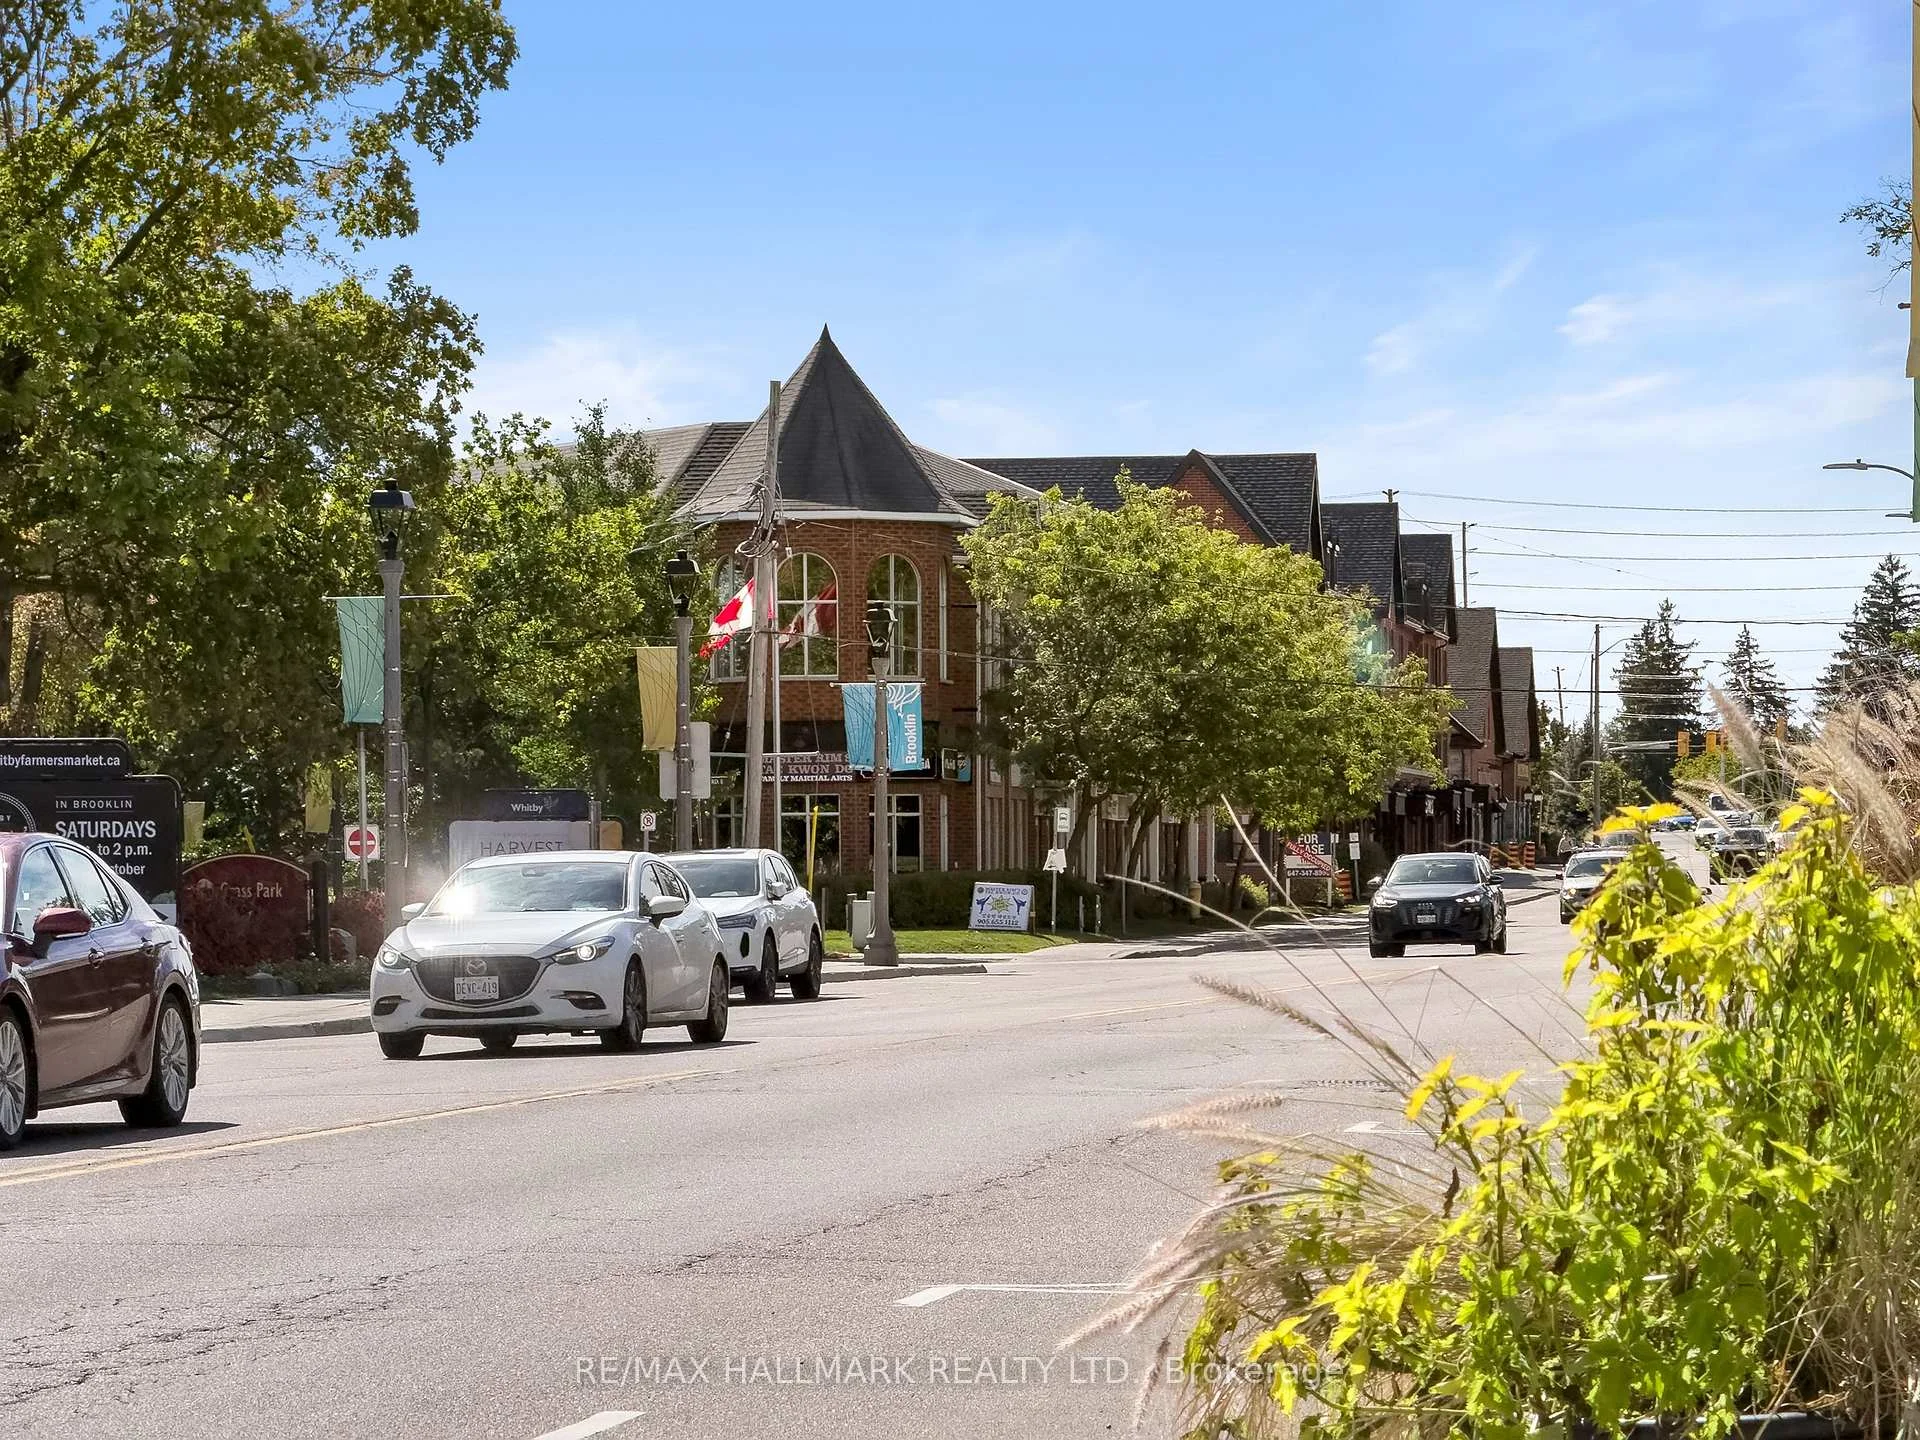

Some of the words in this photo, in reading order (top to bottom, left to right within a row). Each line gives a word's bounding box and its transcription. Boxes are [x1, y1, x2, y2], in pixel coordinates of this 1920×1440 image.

[904, 713, 917, 764] Brooklin
[788, 765, 830, 774] KWON
[55, 800, 67, 809] IN
[73, 800, 132, 809] BROOKLIN
[511, 803, 543, 814] Whitby
[55, 820, 156, 838] SATURDAYS
[1298, 833, 1319, 844] FOR
[97, 843, 110, 856] to
[112, 842, 122, 856] 2
[125, 845, 152, 858] p.m.
[480, 841, 565, 855] HARVEST
[110, 863, 145, 875] tober
[256, 882, 282, 897] Park
